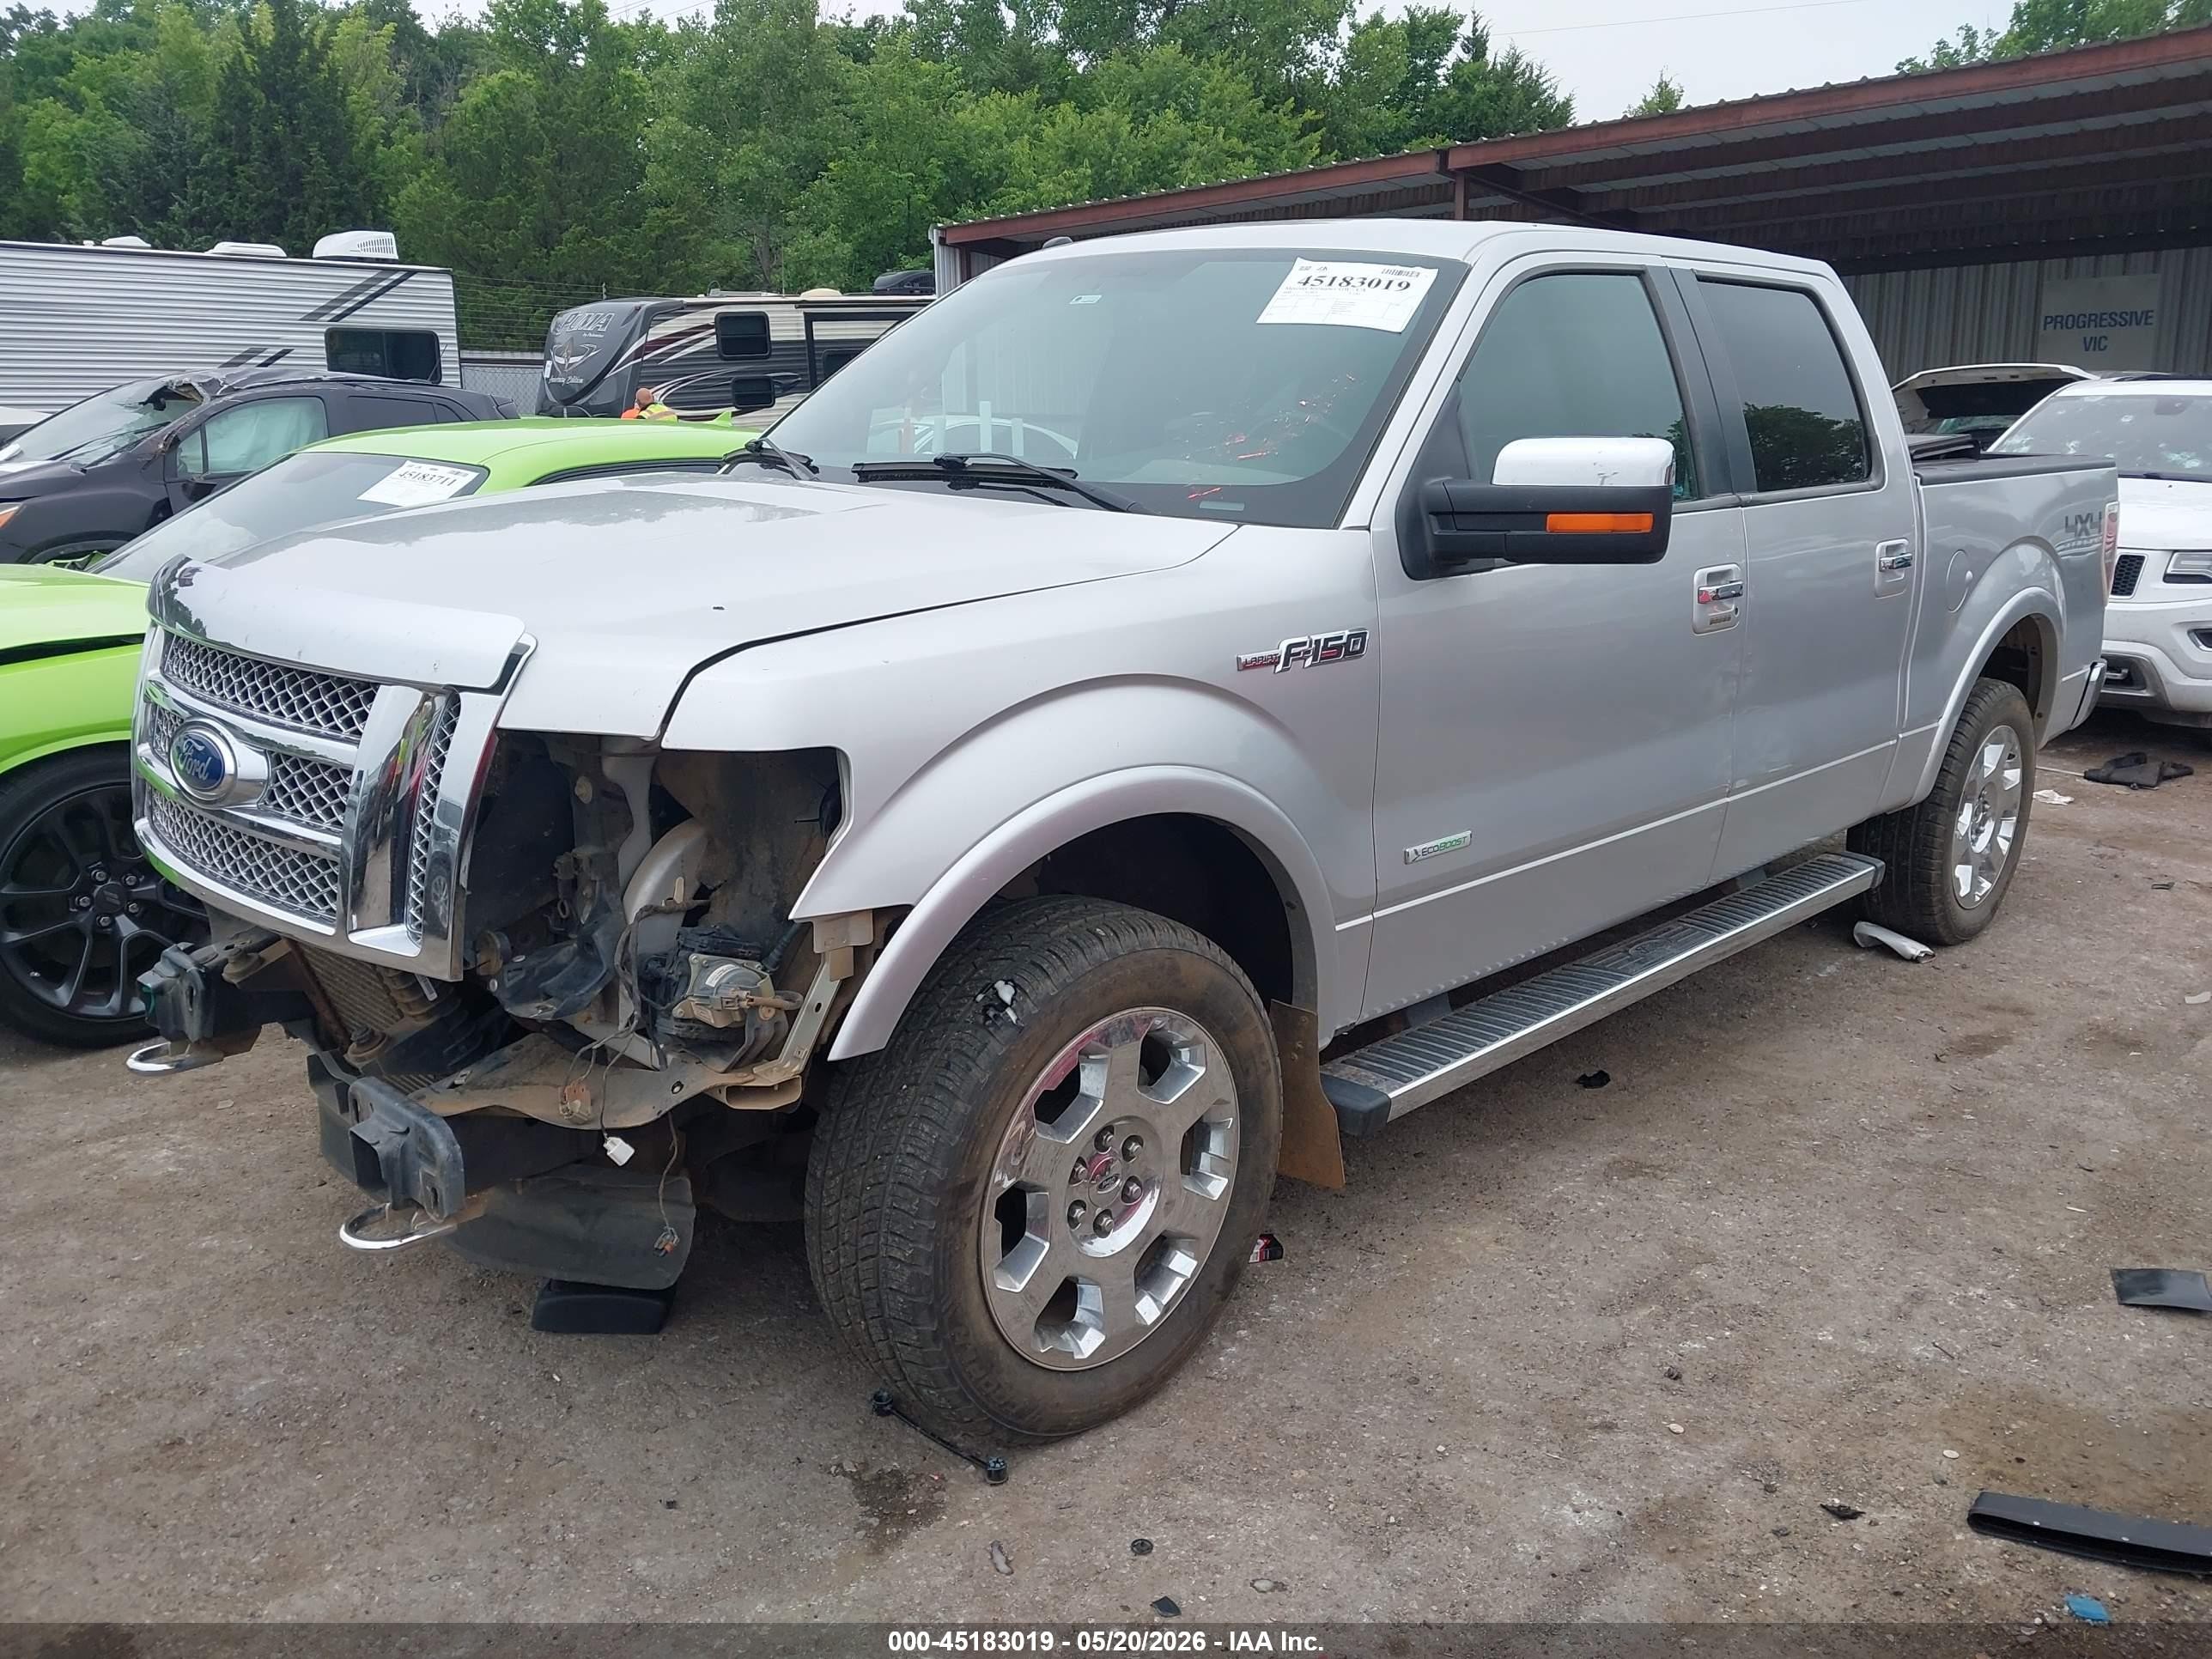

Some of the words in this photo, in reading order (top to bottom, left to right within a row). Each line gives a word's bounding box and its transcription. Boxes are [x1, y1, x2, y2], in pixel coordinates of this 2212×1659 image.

[1297, 275, 1411, 292] 45183019
[2043, 309, 2154, 331] PROGRESSIVE
[2082, 335, 2109, 352] VIC
[1244, 653, 1279, 667] LARIAT
[1274, 628, 1370, 673] F-150
[178, 738, 212, 781] Ford
